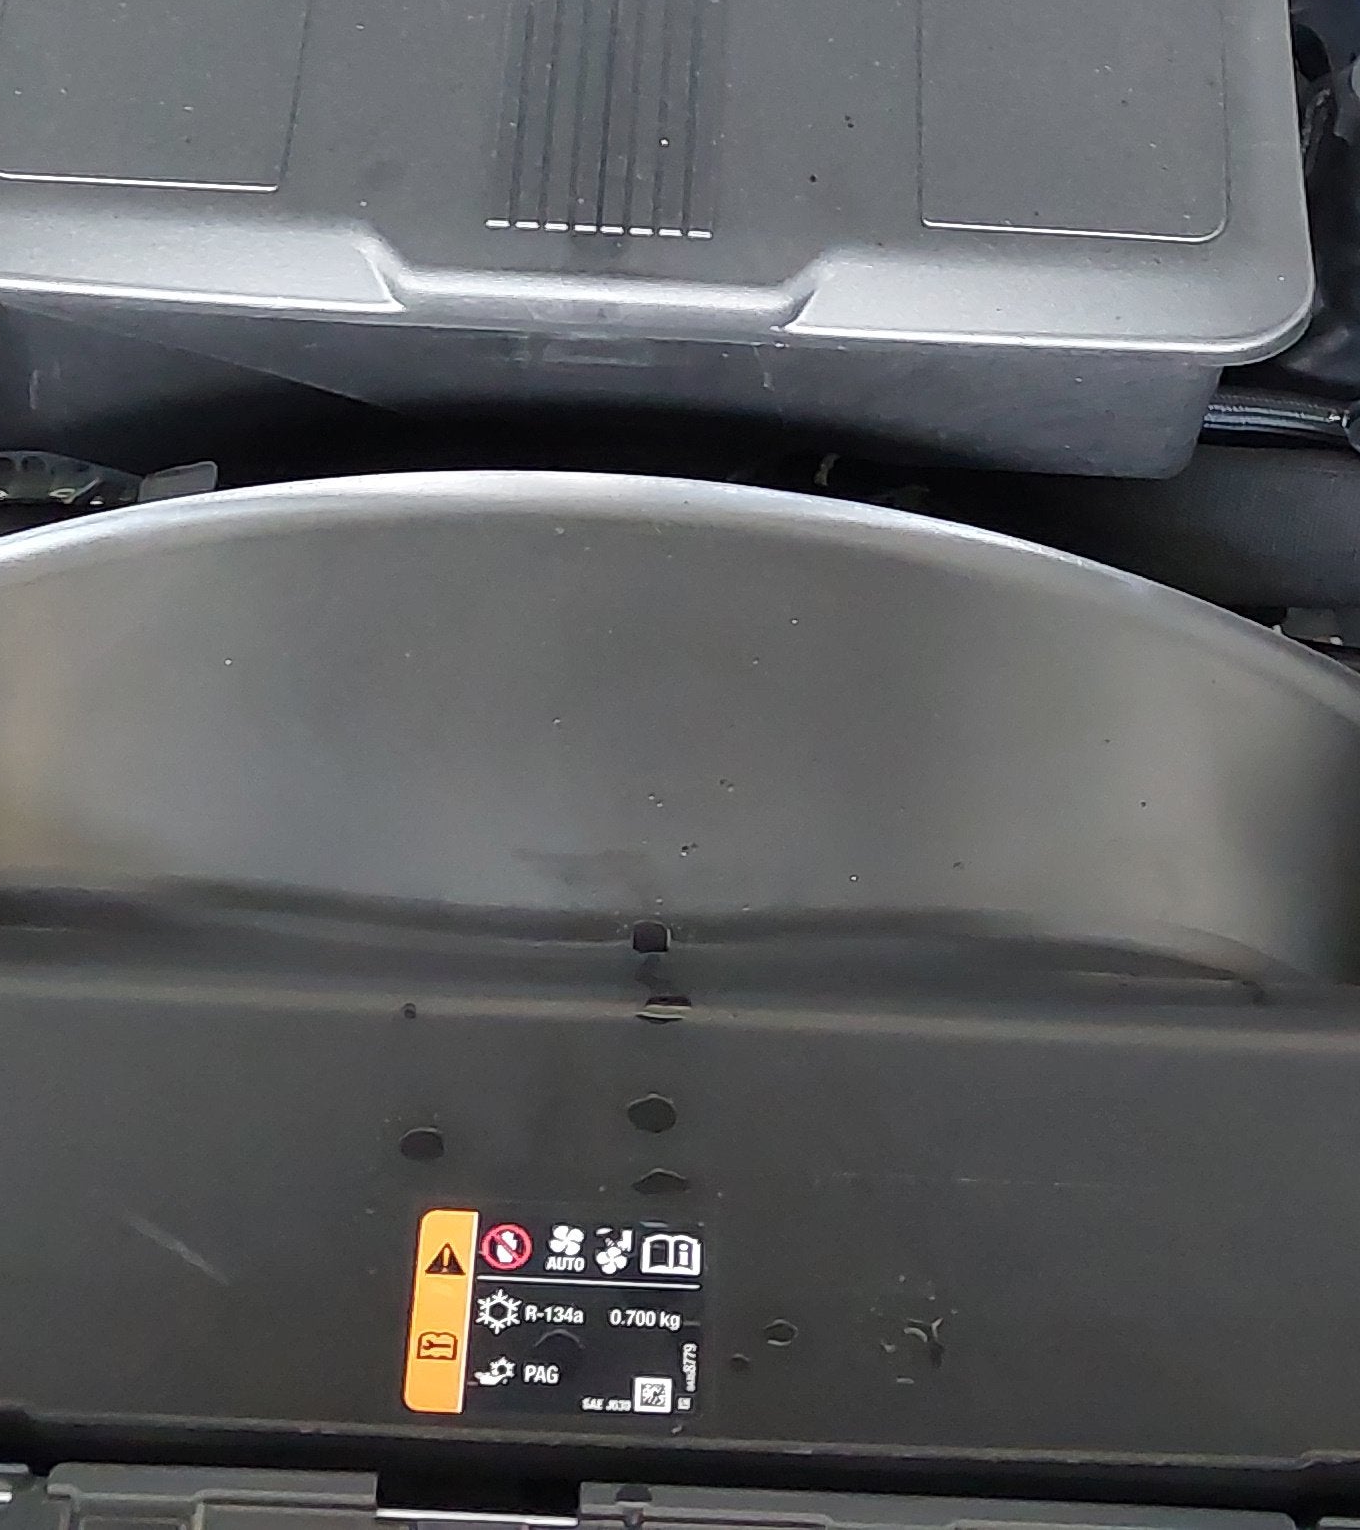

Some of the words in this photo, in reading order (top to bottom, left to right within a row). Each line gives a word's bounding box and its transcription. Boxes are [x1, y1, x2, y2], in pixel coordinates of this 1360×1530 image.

[544, 1256, 586, 1272] AUTO
[524, 1303, 584, 1324] R-134a
[609, 1308, 656, 1327] 0.700
[659, 1310, 681, 1331] kg
[523, 1364, 560, 1384] PAG
